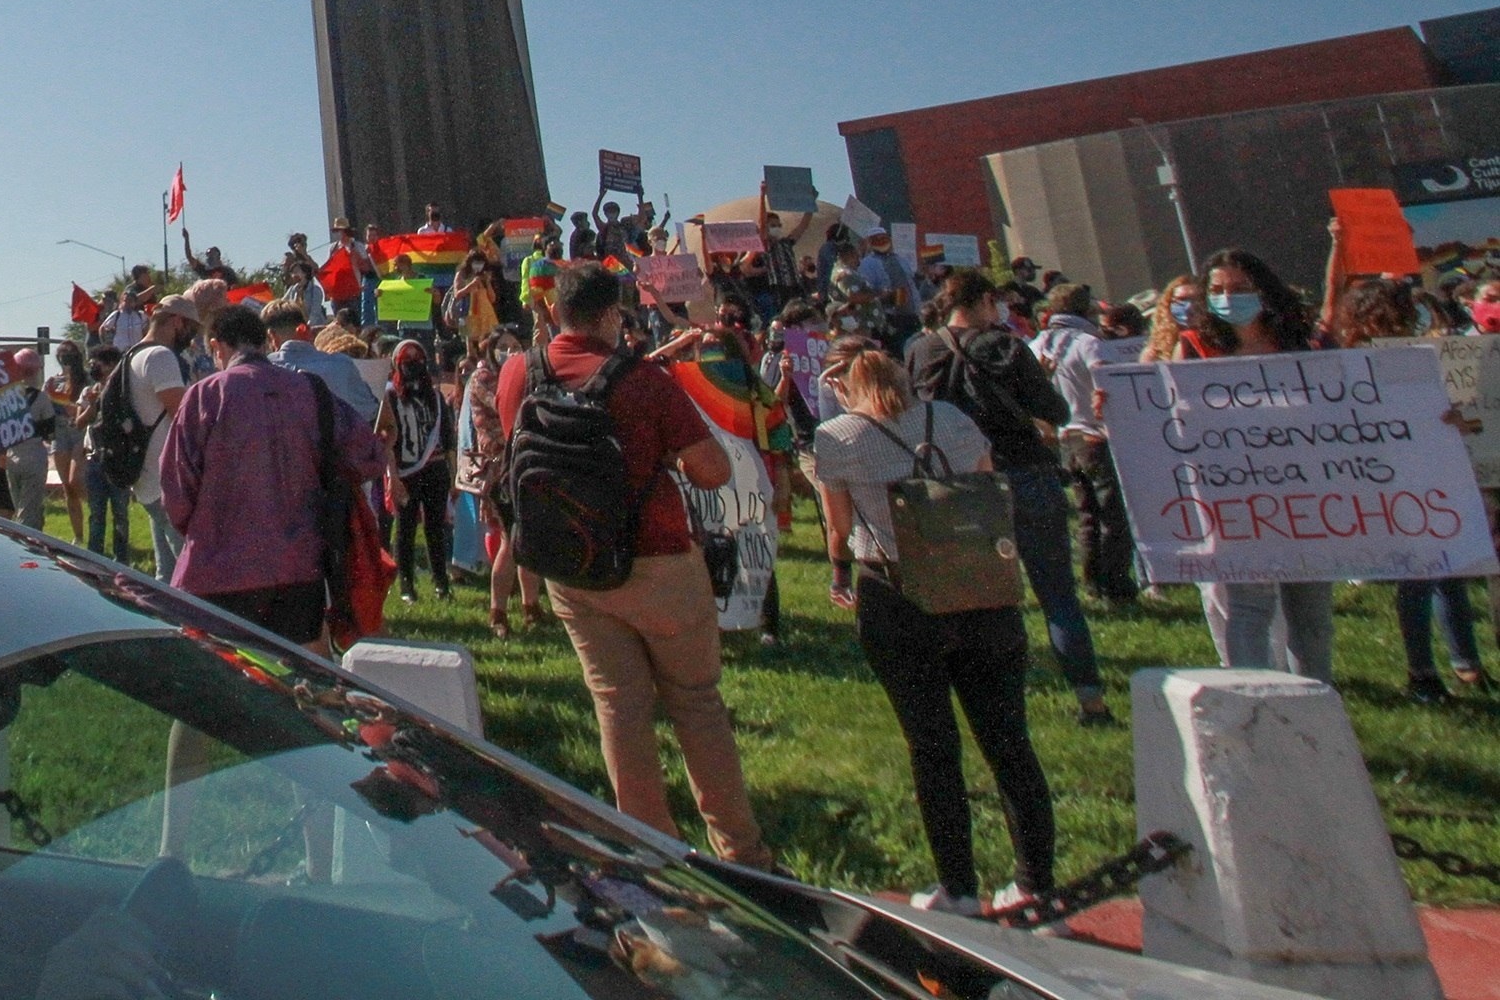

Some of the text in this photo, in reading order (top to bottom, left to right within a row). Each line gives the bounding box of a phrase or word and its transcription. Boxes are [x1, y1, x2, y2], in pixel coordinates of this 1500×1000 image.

[1108, 356, 1382, 411] Tu actitud
[1172, 456, 1395, 500] pisotea mis
[733, 489, 767, 527] LOS
[1160, 488, 1462, 543] DERECHOS
